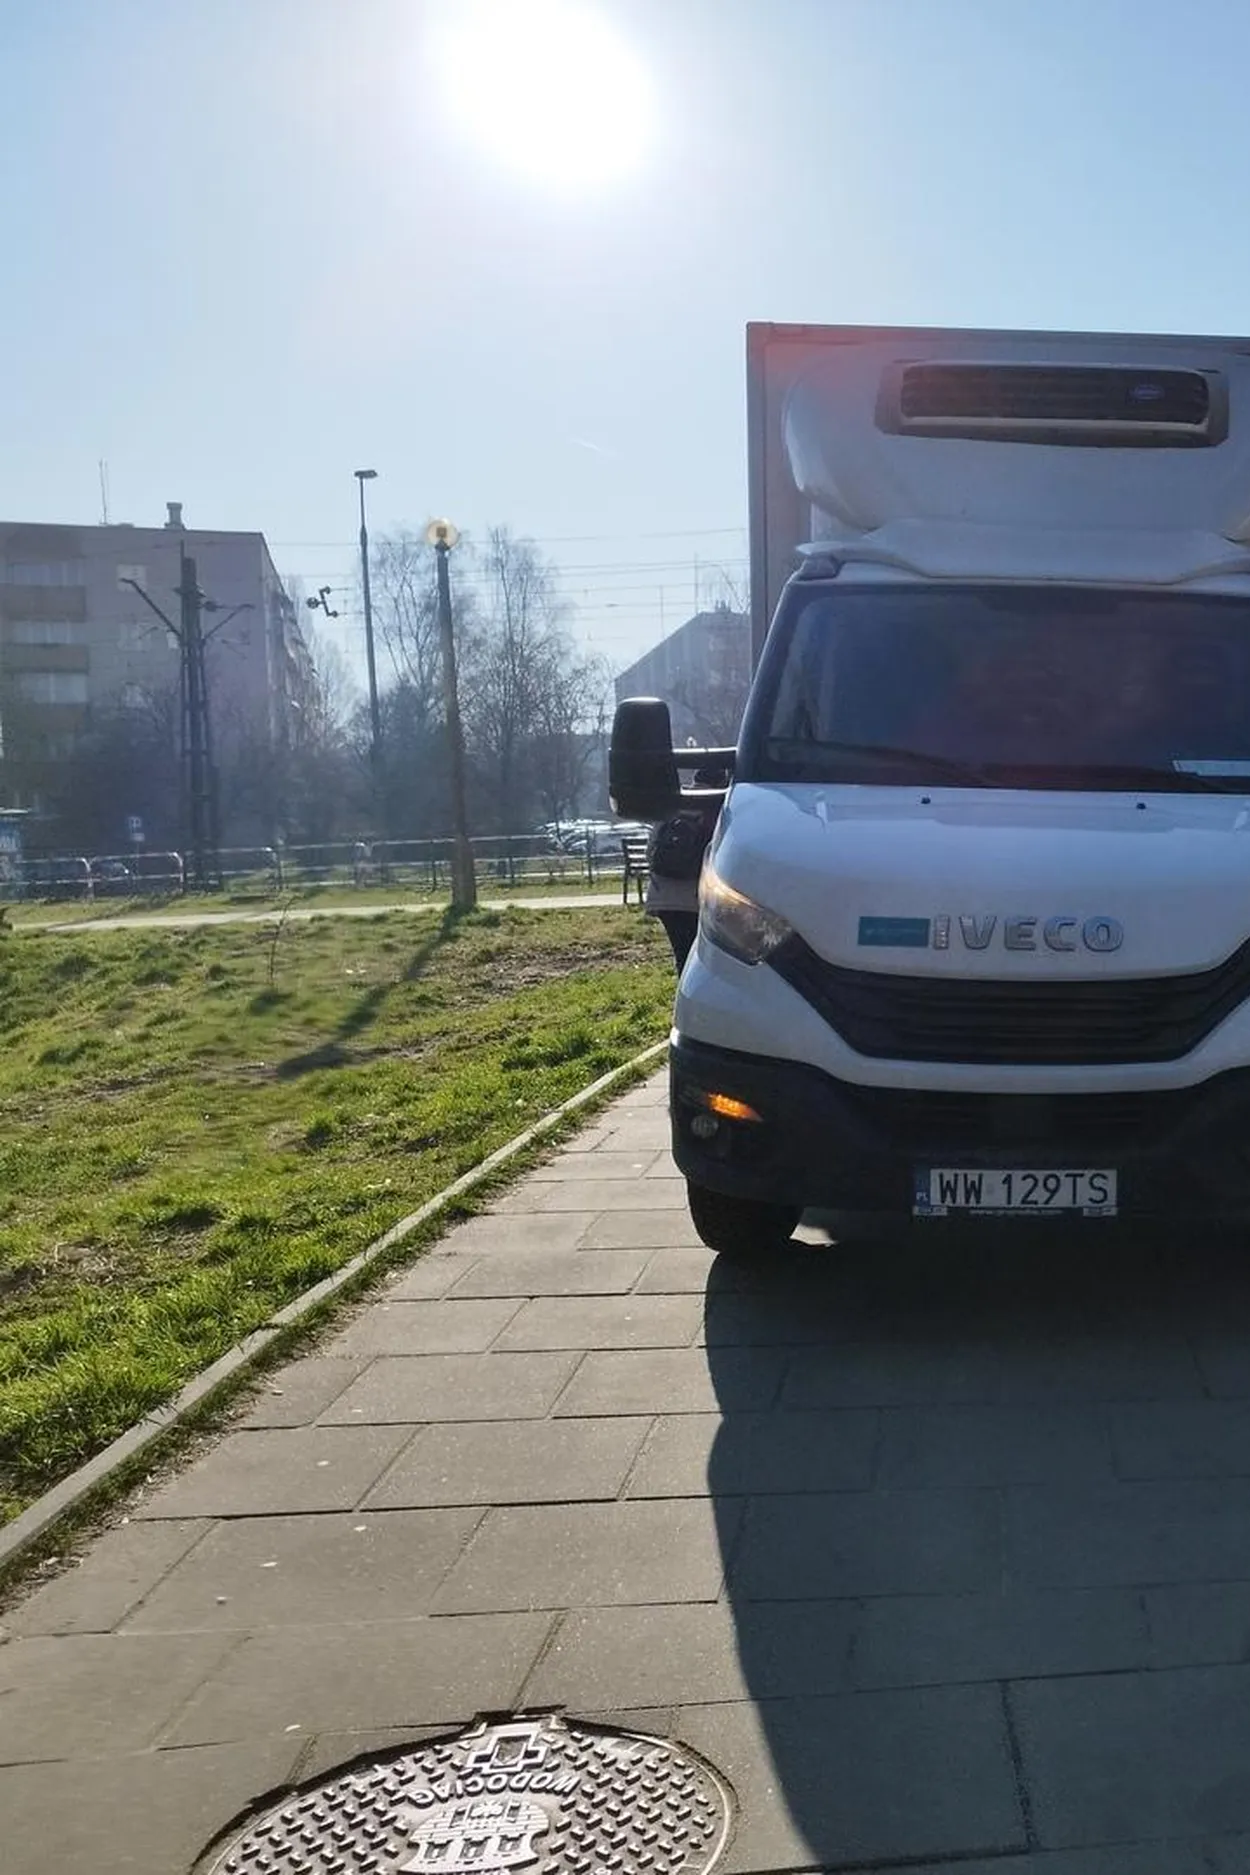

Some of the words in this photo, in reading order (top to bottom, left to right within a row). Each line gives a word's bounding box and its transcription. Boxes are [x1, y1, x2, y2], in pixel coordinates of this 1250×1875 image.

[933, 914, 1124, 953] IVECO
[938, 1172, 983, 1205] WW
[1002, 1172, 1110, 1205] 129TS
